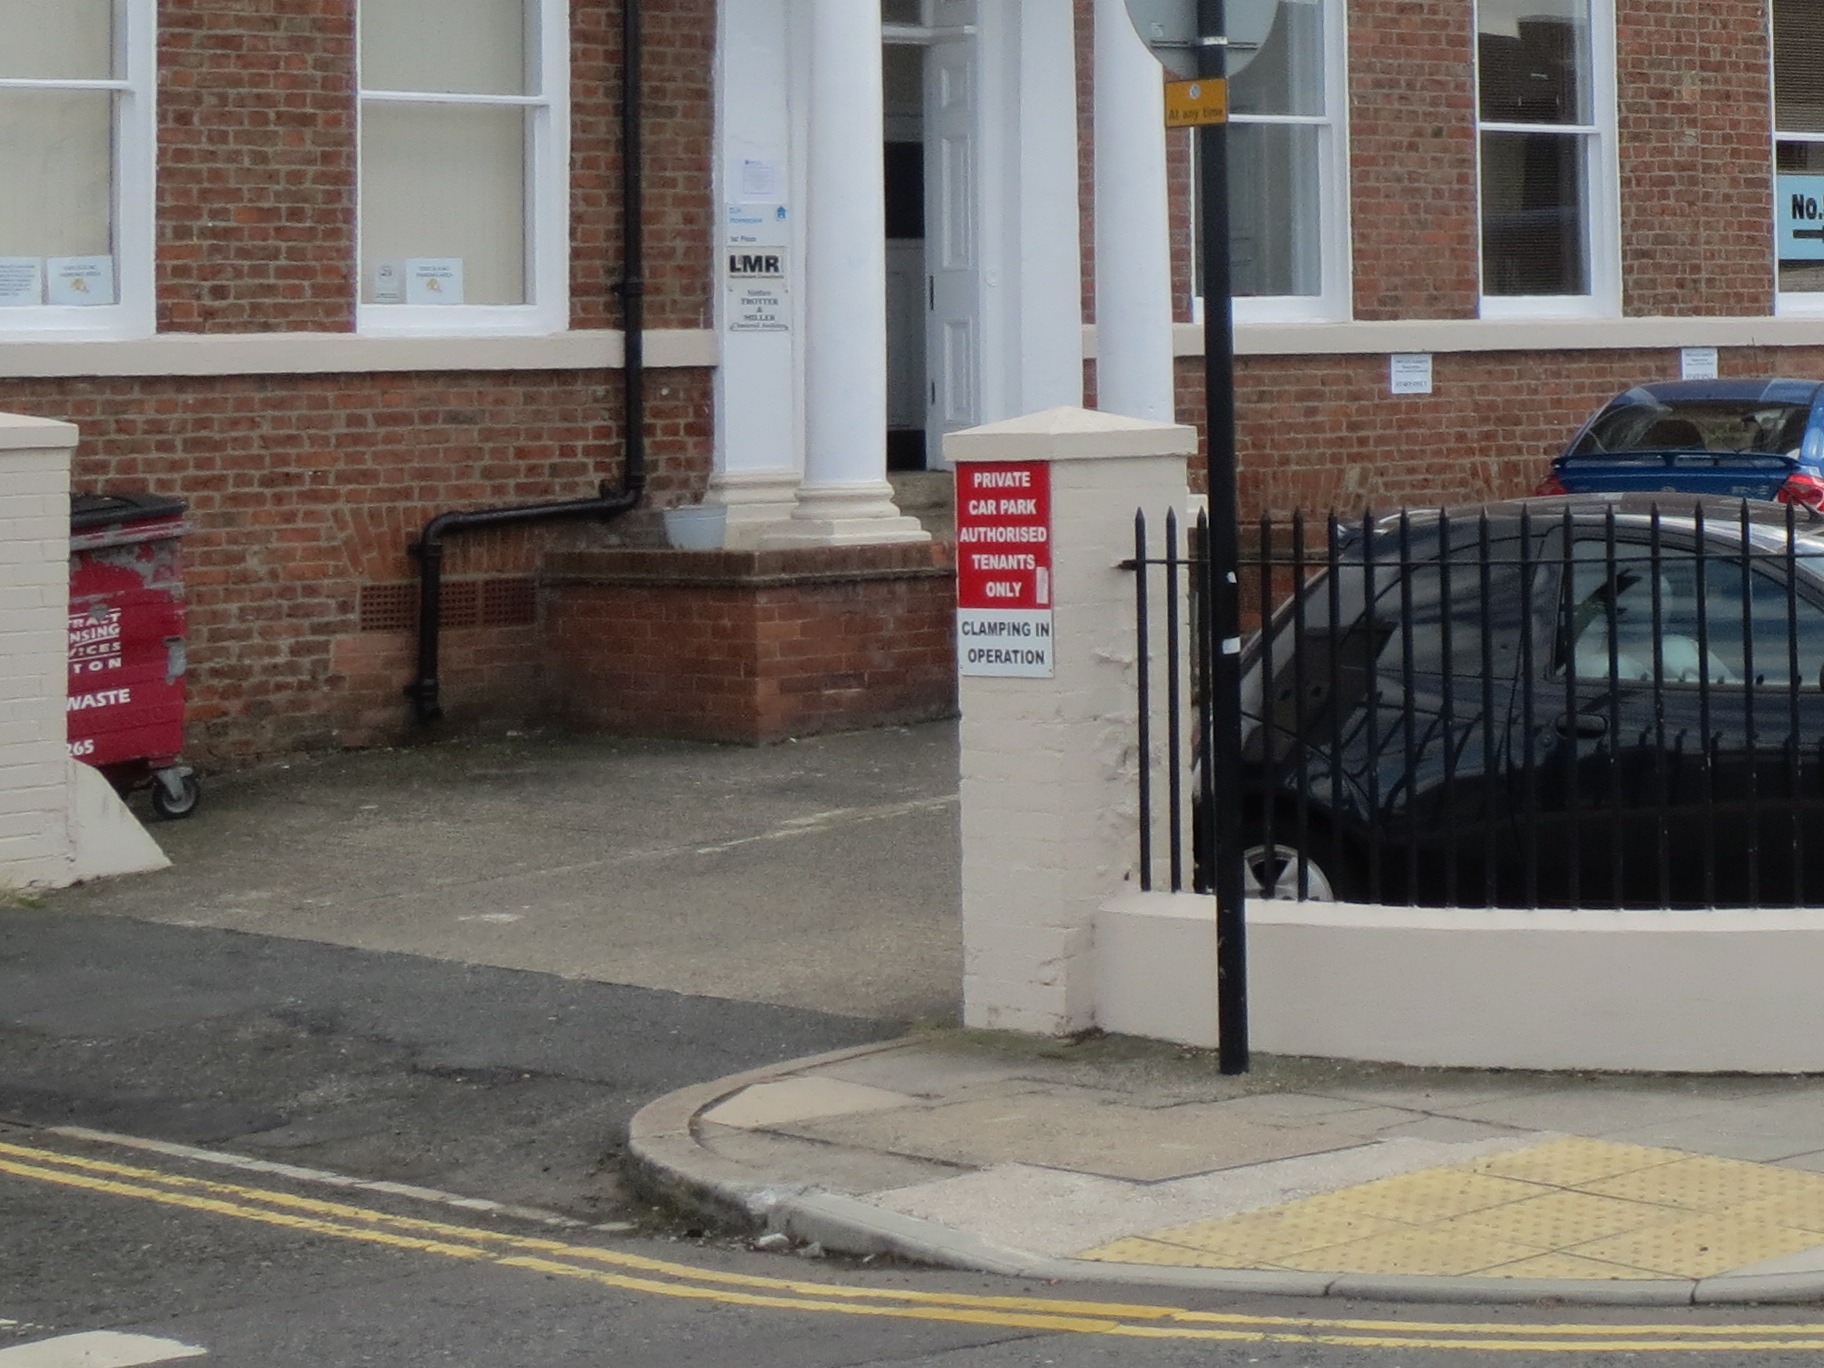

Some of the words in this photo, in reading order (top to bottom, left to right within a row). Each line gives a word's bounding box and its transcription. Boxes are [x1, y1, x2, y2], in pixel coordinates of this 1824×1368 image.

[973, 472, 1031, 488] PRIVATE
[968, 500, 996, 515] CAR
[1000, 499, 1037, 515] PARK
[959, 527, 1047, 543] AUTHORISED
[972, 554, 1036, 570] TENANTS
[986, 581, 1022, 597] ONLY
[962, 621, 1031, 637] CLAMPING
[1036, 622, 1049, 637] IN
[968, 648, 1045, 665] OPERATION
[66, 688, 131, 711] WASTE
